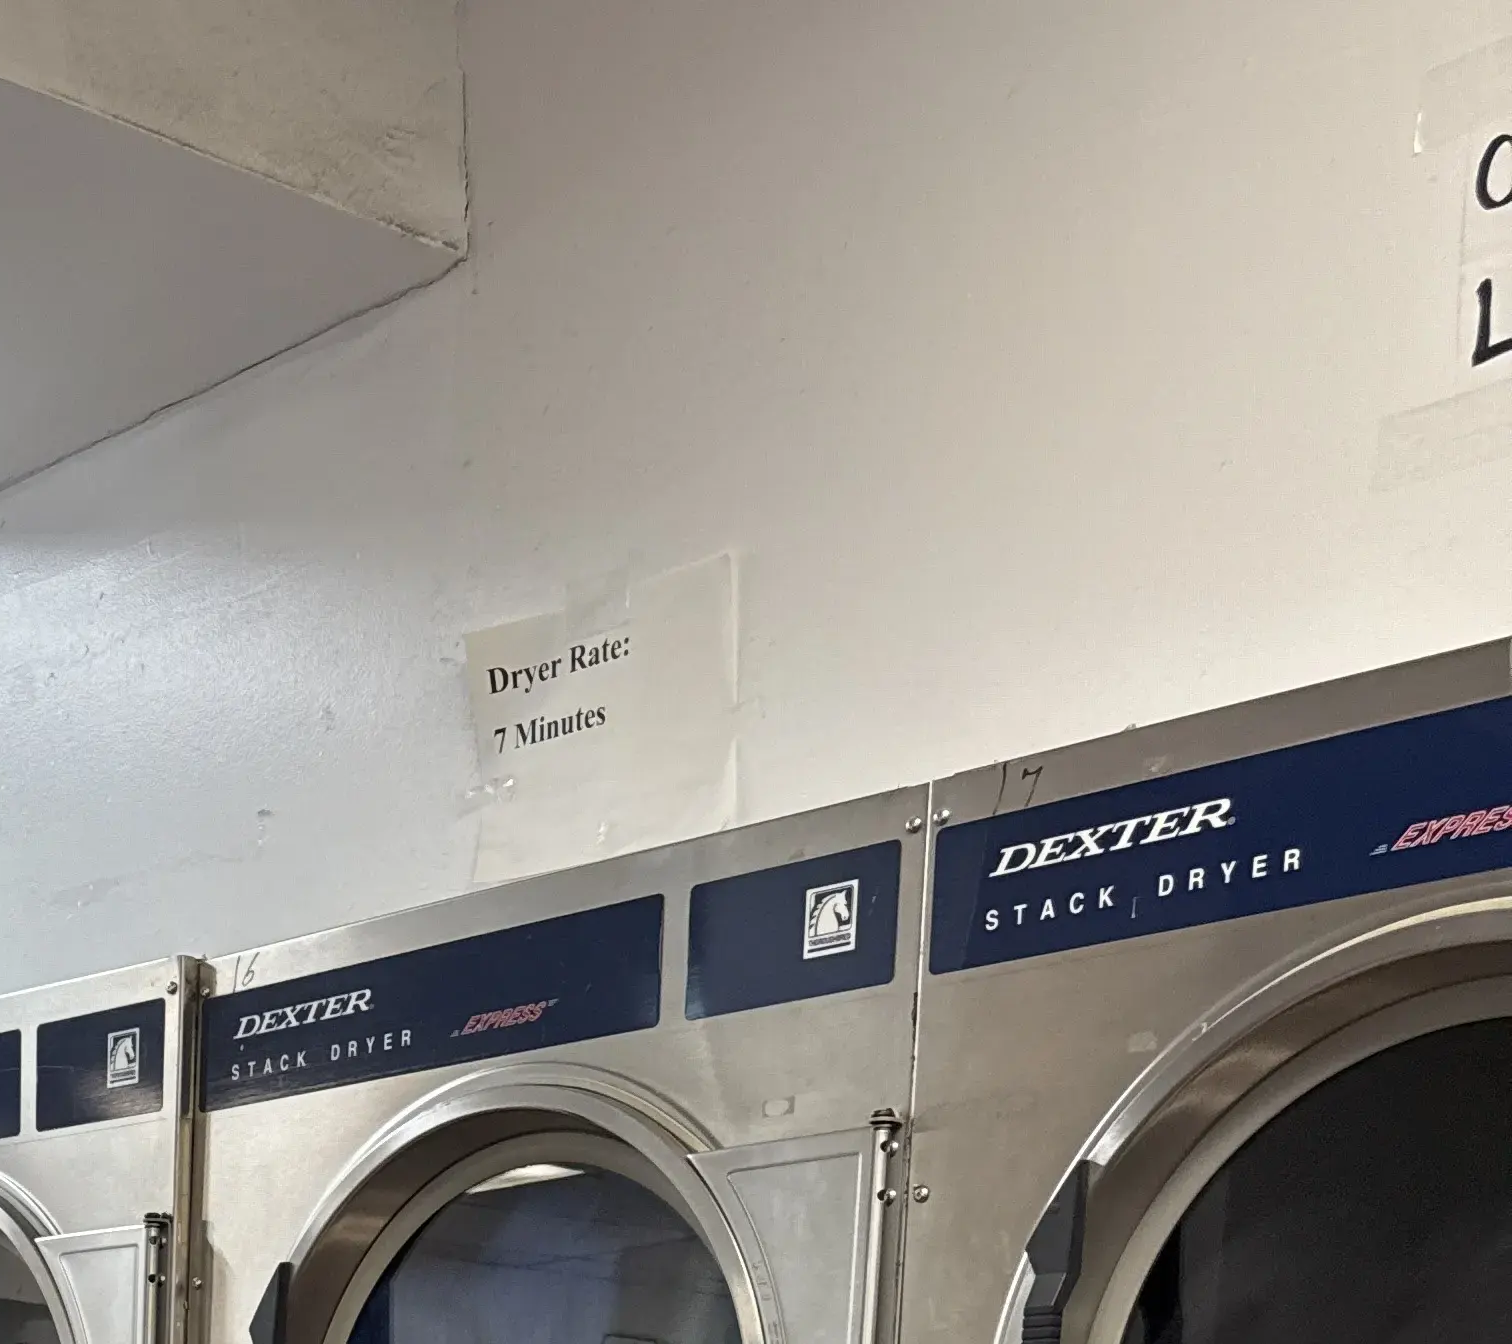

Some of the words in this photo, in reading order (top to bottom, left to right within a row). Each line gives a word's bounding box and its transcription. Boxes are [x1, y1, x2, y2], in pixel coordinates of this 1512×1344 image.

[486, 657, 562, 694] Dryer
[569, 636, 630, 673] Rate:
[493, 727, 507, 754] 7
[515, 705, 606, 749] Minutes
[988, 798, 1233, 878] DEXTER
[985, 886, 1116, 932] STACK
[1158, 848, 1302, 898] DRYER
[233, 988, 372, 1040] DEXTER
[460, 1001, 546, 1036] EXPRESS
[231, 1050, 308, 1081] STACK
[330, 1029, 412, 1061] DRYER
